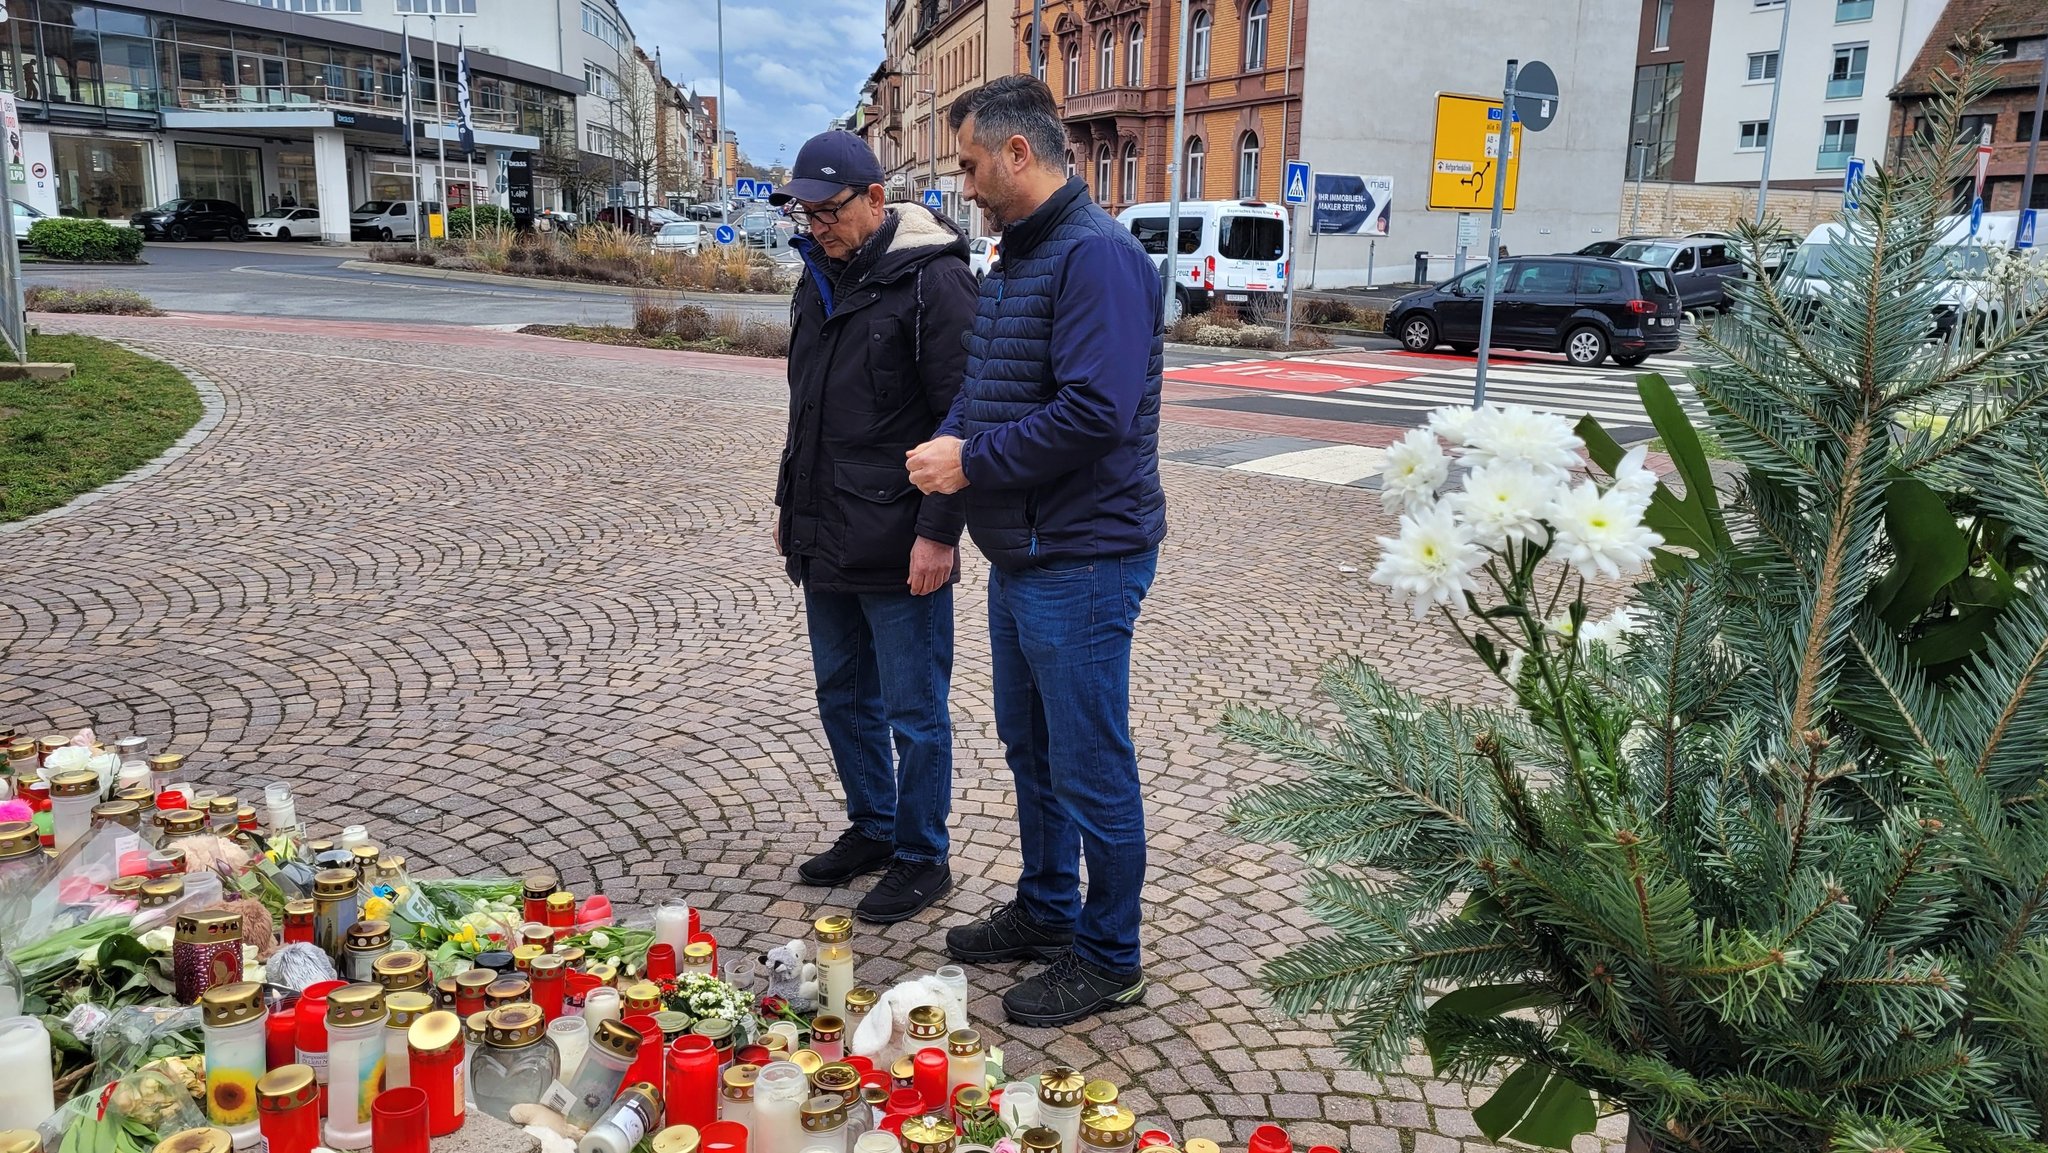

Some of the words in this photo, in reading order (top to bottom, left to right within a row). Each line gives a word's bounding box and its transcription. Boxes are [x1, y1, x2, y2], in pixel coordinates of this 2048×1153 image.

[1370, 181, 1390, 191] may
[1318, 193, 1329, 201] IHR
[1329, 194, 1366, 203] IMMOBILIEN-
[1317, 202, 1341, 211] MAKLER
[1355, 204, 1367, 212] 1966
[1175, 269, 1190, 277] reuz
